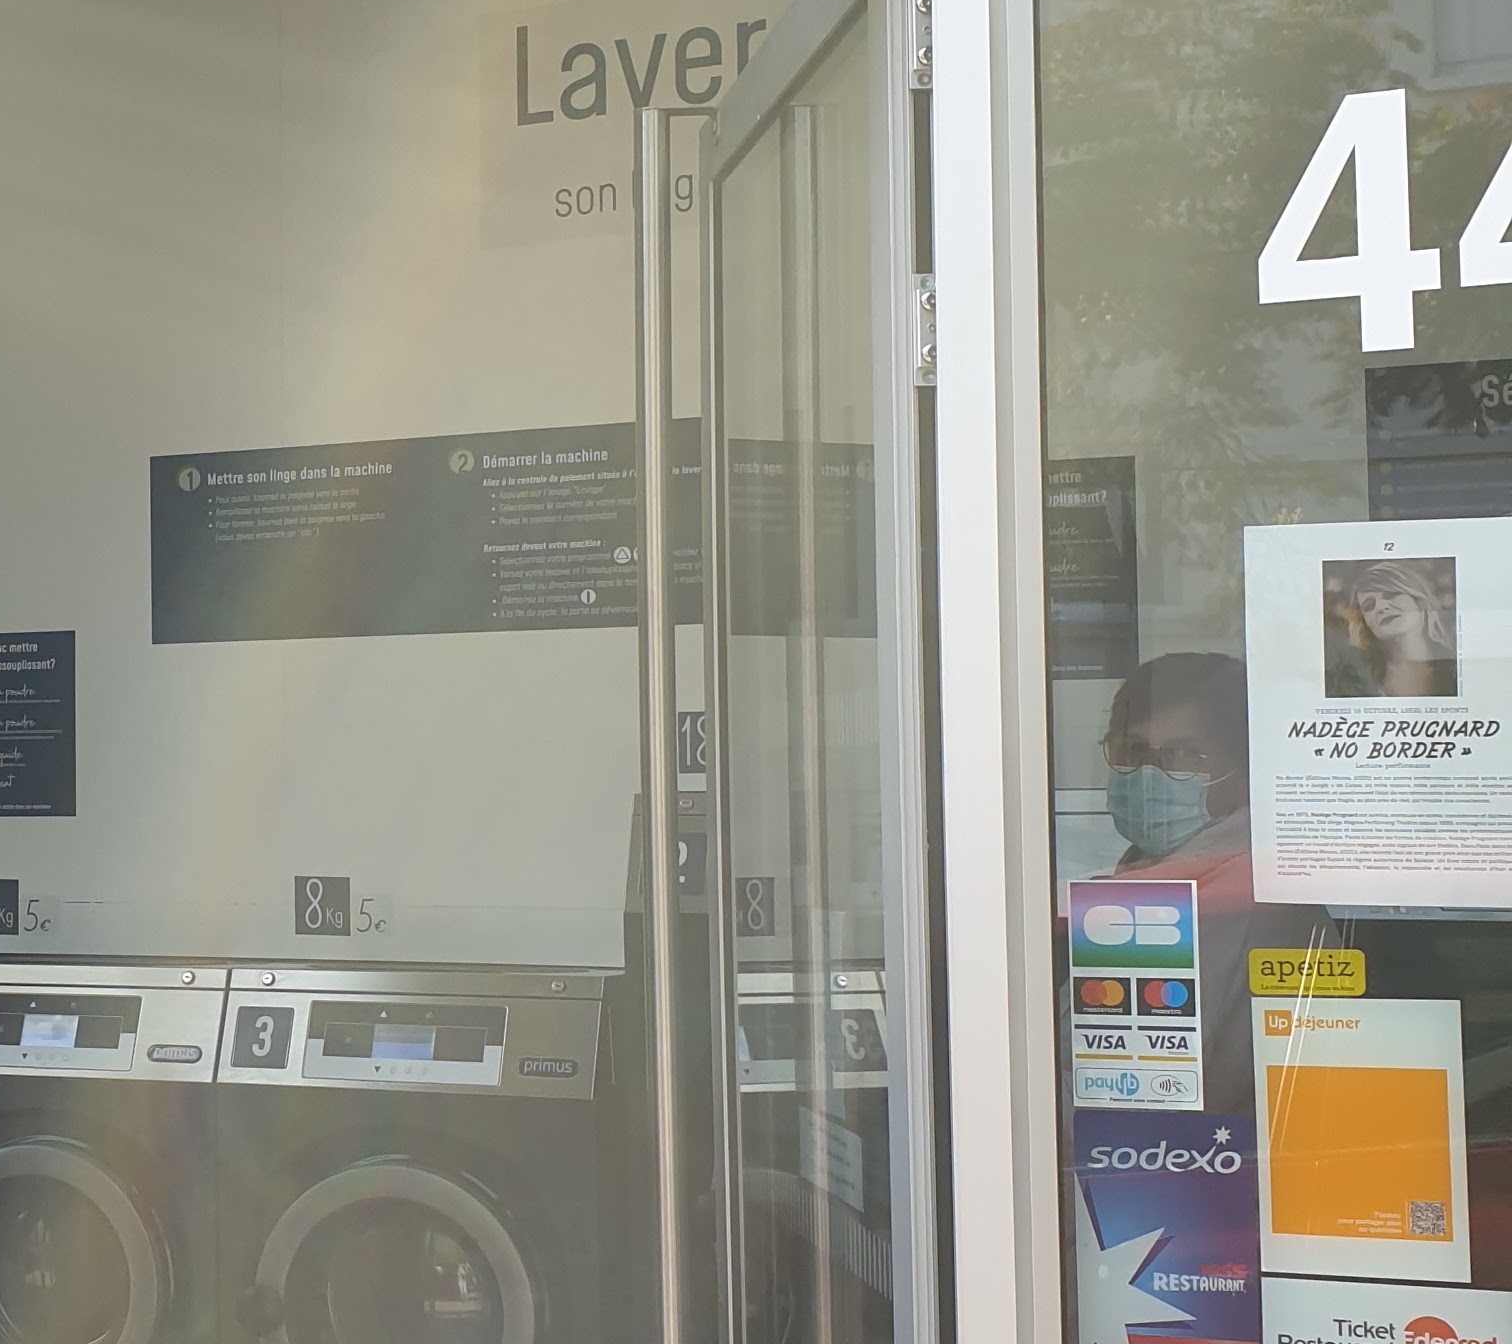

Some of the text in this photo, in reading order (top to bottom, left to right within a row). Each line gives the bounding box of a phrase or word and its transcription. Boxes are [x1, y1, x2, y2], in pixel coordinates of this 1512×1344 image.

[555, 182, 617, 218] son
[482, 448, 608, 469] Démarrer la machine
[207, 461, 393, 486] Mettre son linge dans la machine
[9, 641, 38, 653] mettre
[1287, 716, 1501, 739] NADÈGE PRUGNARD
[1329, 741, 1456, 759] NO BORDER
[305, 878, 324, 930] 8
[1083, 905, 1181, 946] CB
[1260, 954, 1355, 983] apetiz
[1267, 1014, 1361, 1032] Up déjeuner
[251, 1015, 275, 1057] 3
[1080, 1034, 1127, 1050] VISA
[1144, 1035, 1189, 1050] VISA
[523, 1058, 573, 1075] primus
[1087, 1140, 1243, 1174] sodexo
[1152, 1272, 1246, 1293] RESTAURANT
[1332, 1318, 1396, 1341] Ticket
